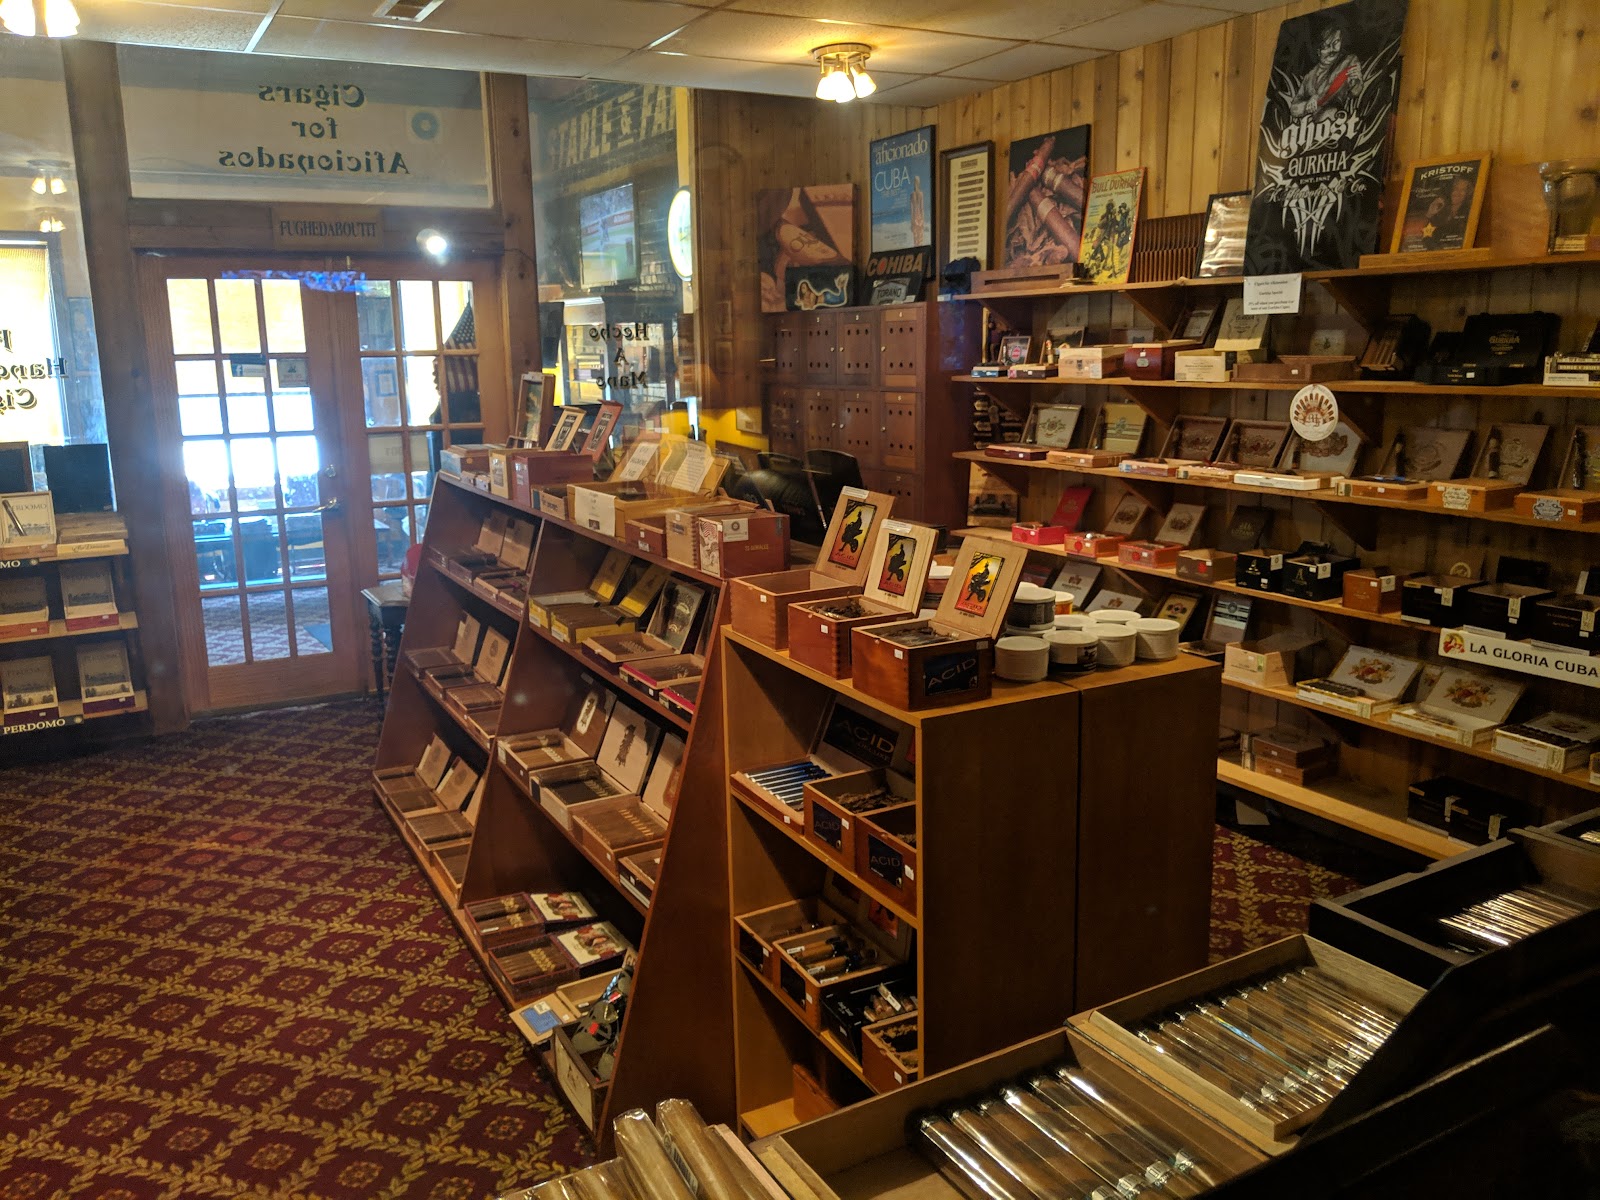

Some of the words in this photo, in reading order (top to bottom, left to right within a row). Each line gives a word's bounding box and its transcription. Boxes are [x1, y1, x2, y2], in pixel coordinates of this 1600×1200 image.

[1280, 112, 1360, 159] ghost
[875, 133, 928, 166] aficionado
[1288, 151, 1347, 177] GURKHA
[1420, 165, 1474, 181] KRISTOFF
[874, 166, 911, 192] CUBA
[866, 252, 923, 277] COHIBA
[10, 502, 48, 512] ERDOMO
[1469, 642, 1488, 656] LA
[1492, 647, 1549, 668] GLORIA
[1554, 660, 1599, 678] CUBA
[928, 658, 977, 689] ACID
[3, 718, 66, 735] PERDOMO
[835, 718, 895, 753] ACID
[814, 820, 840, 831] ACID
[870, 855, 901, 867] ACID
